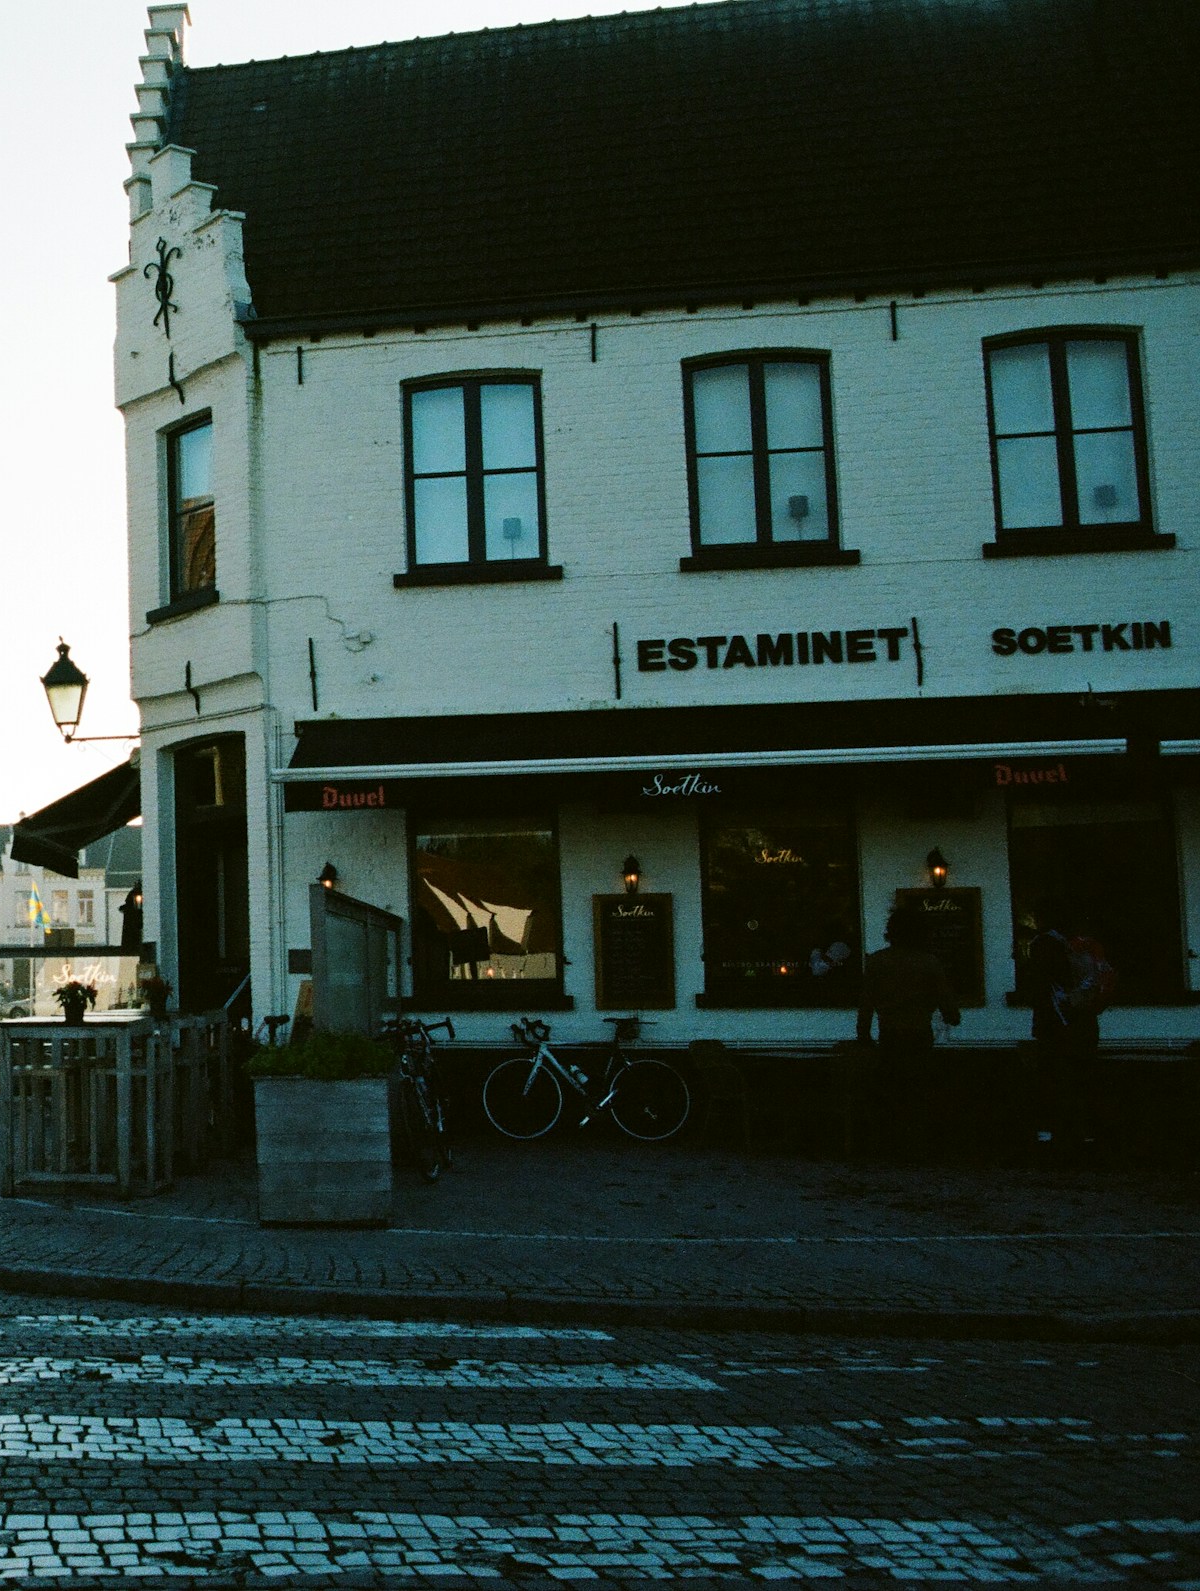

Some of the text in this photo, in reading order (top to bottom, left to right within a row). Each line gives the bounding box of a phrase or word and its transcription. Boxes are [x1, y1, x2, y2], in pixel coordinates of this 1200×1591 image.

[637, 620, 1172, 672] ESTAMINET SOETKIN
[640, 772, 722, 797] Soetkin
[994, 763, 1069, 785] Duvel
[322, 784, 385, 808] Duvel
[754, 847, 805, 864] Soetkin
[611, 904, 656, 917] Soetkin
[51, 962, 117, 986] Soetkin
